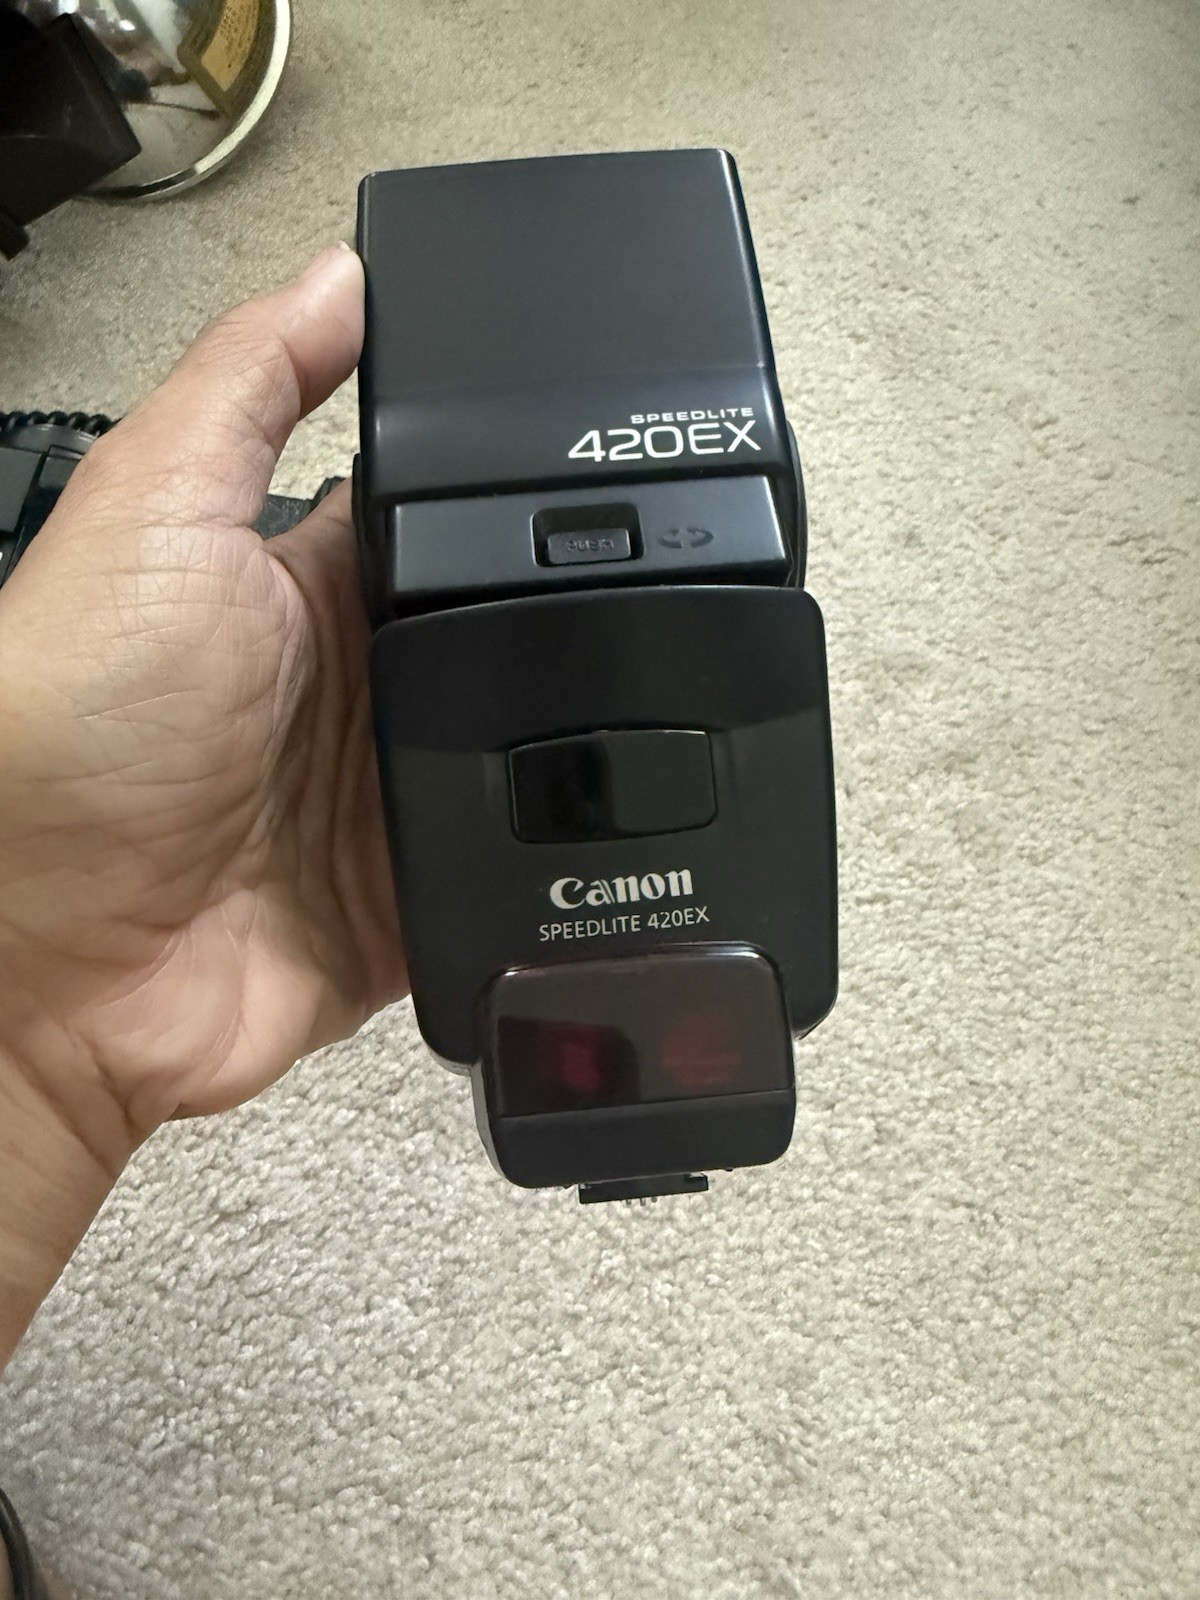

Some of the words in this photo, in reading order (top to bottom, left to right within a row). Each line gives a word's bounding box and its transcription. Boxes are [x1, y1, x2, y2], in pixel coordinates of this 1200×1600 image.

[630, 407, 755, 425] SPEEDLITE
[567, 419, 762, 462] 420EX
[549, 868, 694, 910] Canon
[538, 914, 642, 942] SPEEDLITE
[647, 905, 711, 930] 420EX
